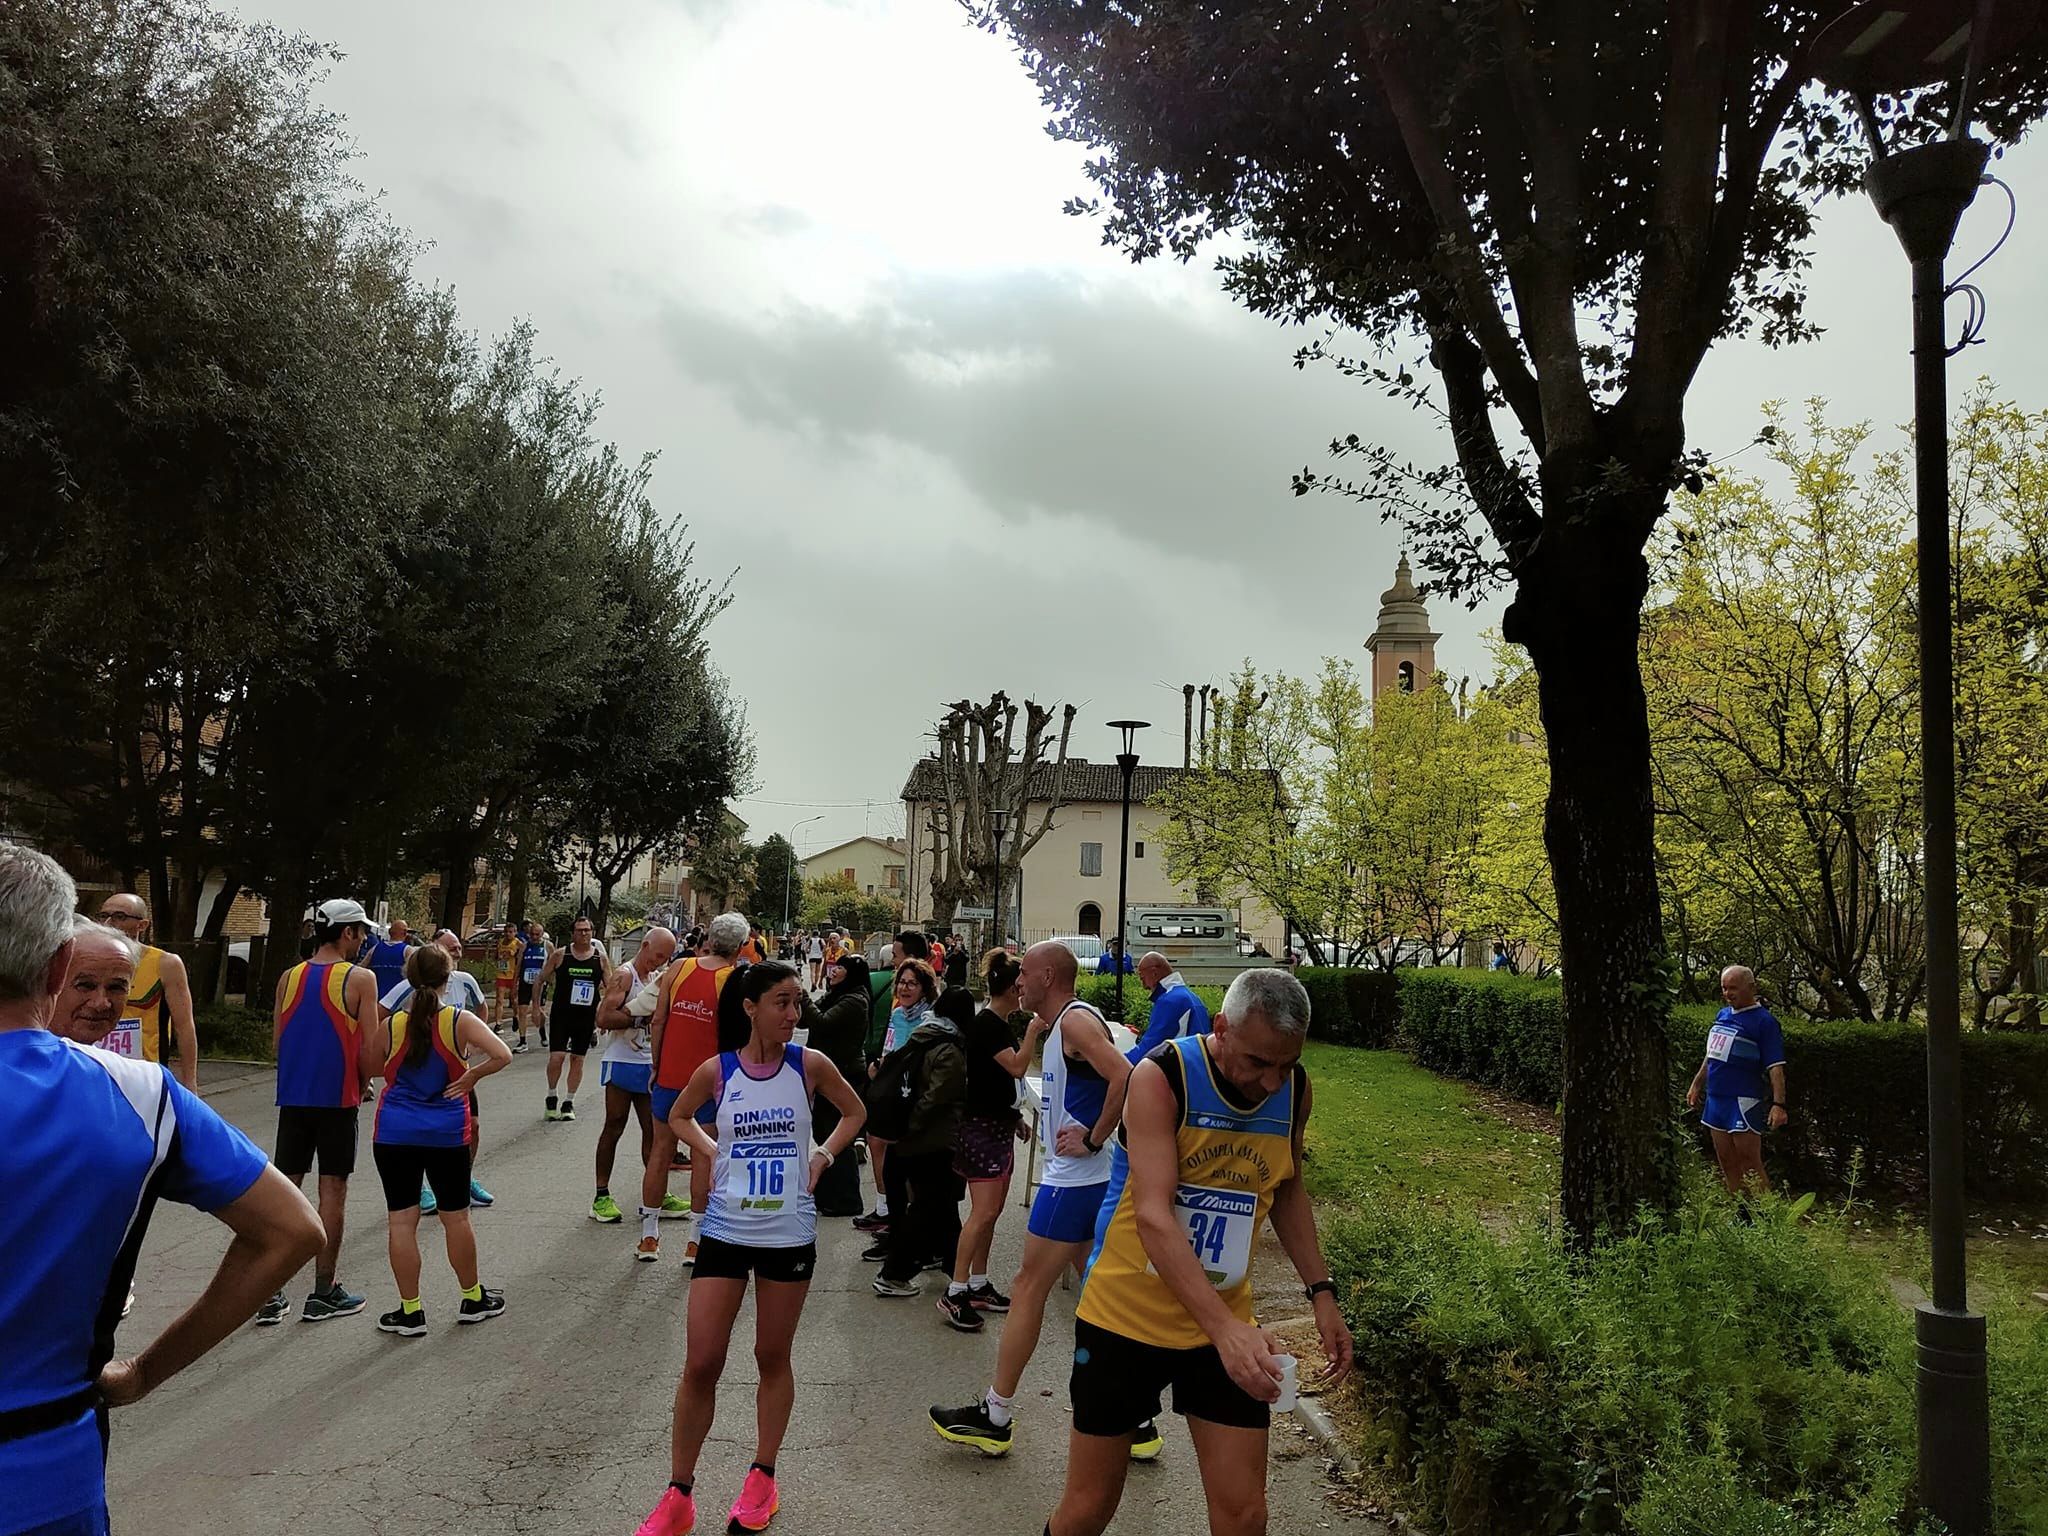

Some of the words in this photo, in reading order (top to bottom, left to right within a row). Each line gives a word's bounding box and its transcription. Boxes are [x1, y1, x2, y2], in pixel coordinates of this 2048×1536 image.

[580, 986, 590, 1000] 41
[1710, 1033, 1727, 1051] 214
[733, 1107, 795, 1125] DINAMO
[733, 1121, 796, 1138] RUNNING
[753, 1146, 797, 1156] MIZUNO
[1187, 1143, 1234, 1169] OLIMPIA
[746, 1159, 785, 1196] 116
[1198, 1195, 1253, 1213] MIZUNO
[1188, 1212, 1228, 1264] 34
